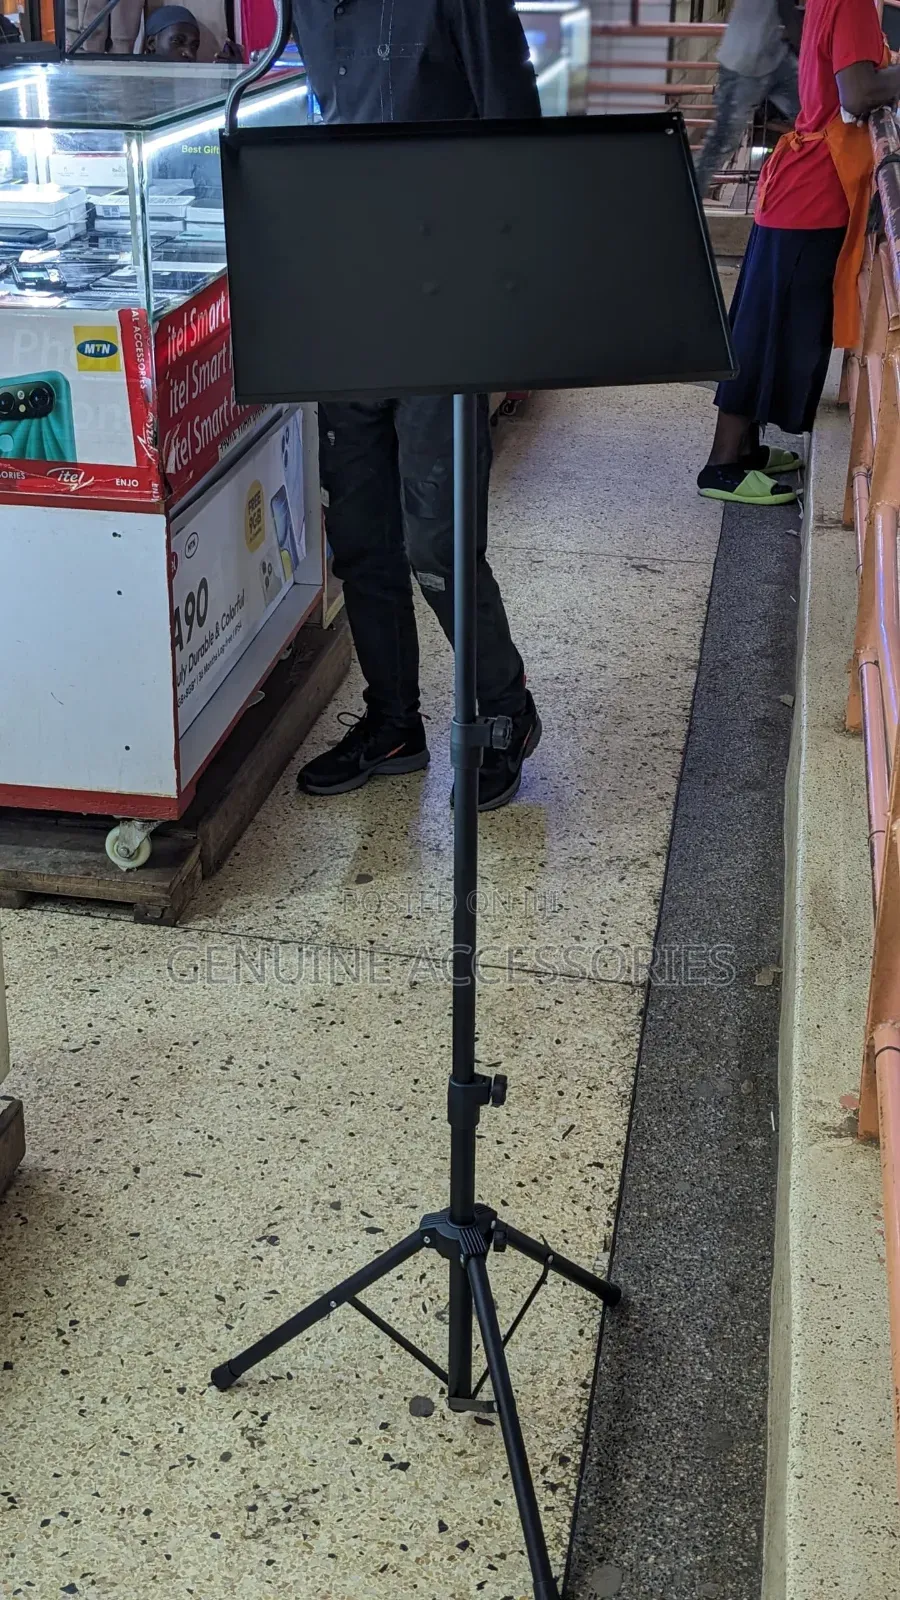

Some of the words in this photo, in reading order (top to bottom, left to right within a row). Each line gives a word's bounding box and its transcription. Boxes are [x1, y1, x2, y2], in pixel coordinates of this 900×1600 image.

[181, 144, 202, 154] Best
[84, 343, 111, 354] MTN
[168, 312, 188, 365] itel
[190, 291, 226, 347] Smart
[170, 365, 189, 418] itel
[192, 341, 227, 399] Smart
[193, 396, 229, 455] Smart
[116, 478, 140, 487] ENJO
[248, 490, 261, 515] FREE
[173, 576, 209, 653] A90
[188, 630, 214, 674] Durable
[215, 620, 220, 640] &
[220, 588, 245, 632] Colorful
[204, 653, 218, 675] Months
